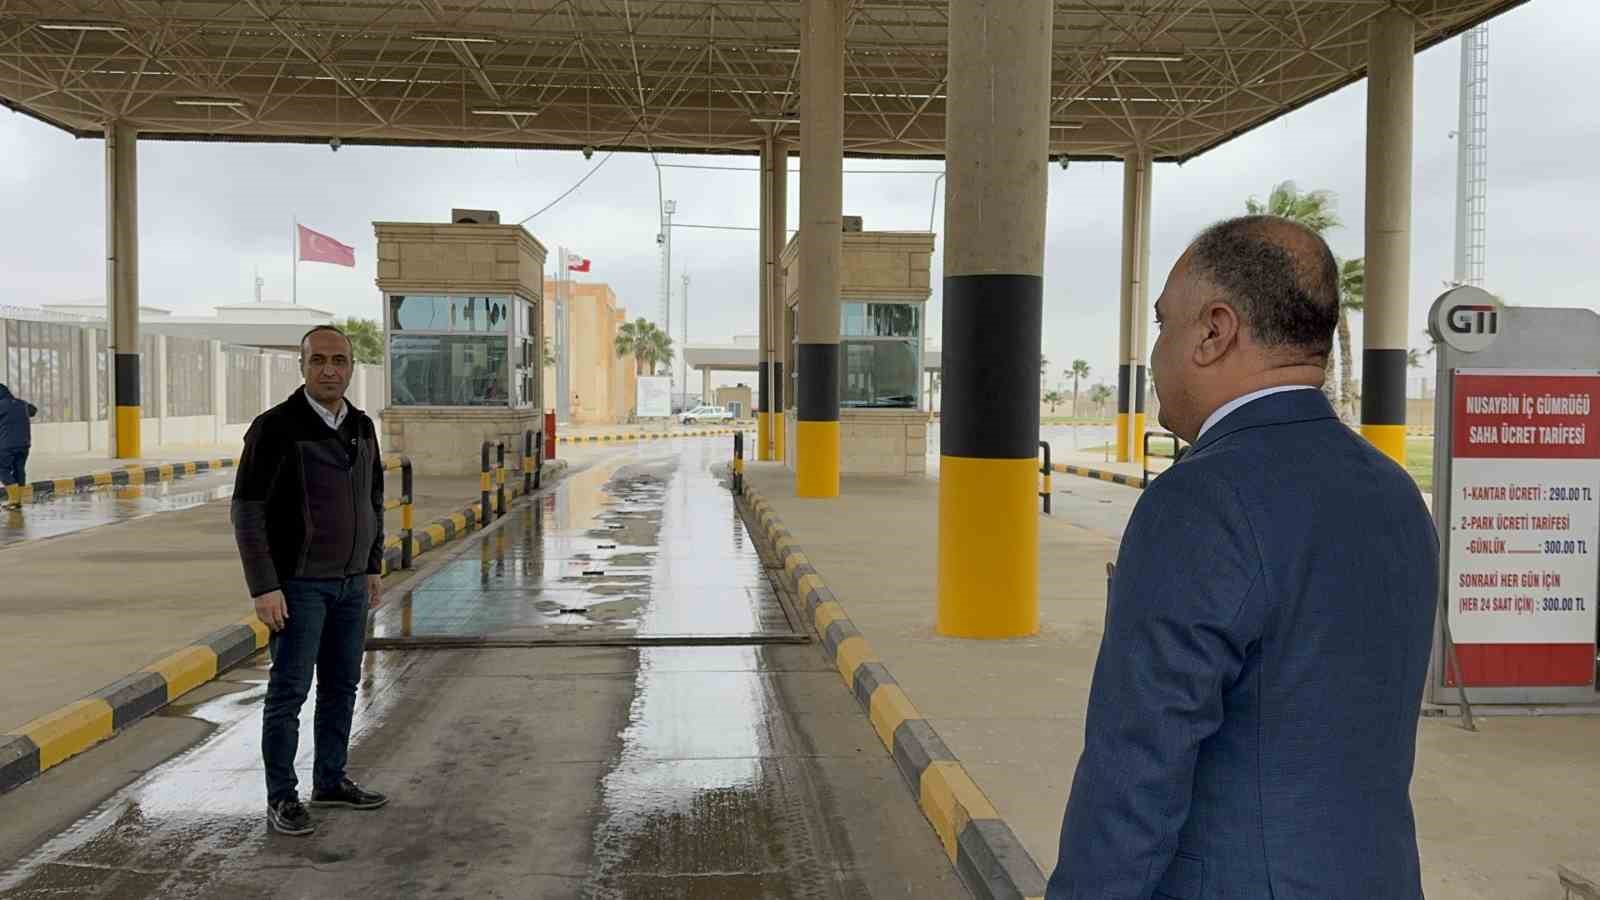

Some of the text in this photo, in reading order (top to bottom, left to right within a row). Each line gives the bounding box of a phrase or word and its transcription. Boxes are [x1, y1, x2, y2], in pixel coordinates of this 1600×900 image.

[1466, 394, 1590, 419] NUSAYBİN İÇ GÜMRÜĞÜ
[1469, 423, 1585, 445] SAHA ÜCRET TARİFESİ
[1463, 486, 1506, 501] 1-KANTAR
[1509, 483, 1541, 501] ÜCRETİ
[1549, 487, 1580, 501] 290.00
[1582, 488, 1592, 501] TL
[1461, 513, 1570, 530] 2-PARK ÜCRETİ TARİFESİ
[1544, 540, 1575, 554] 300.00
[1578, 540, 1588, 554] TL
[1459, 570, 1561, 591] SONRAKİ HER GÜN İÇİN
[1459, 597, 1478, 614] (HER
[1480, 598, 1491, 611] 24
[1493, 597, 1513, 611] SAAT
[1515, 594, 1534, 615] İÇİN)
[1542, 597, 1573, 611] 300.00
[1575, 597, 1586, 611] TL
